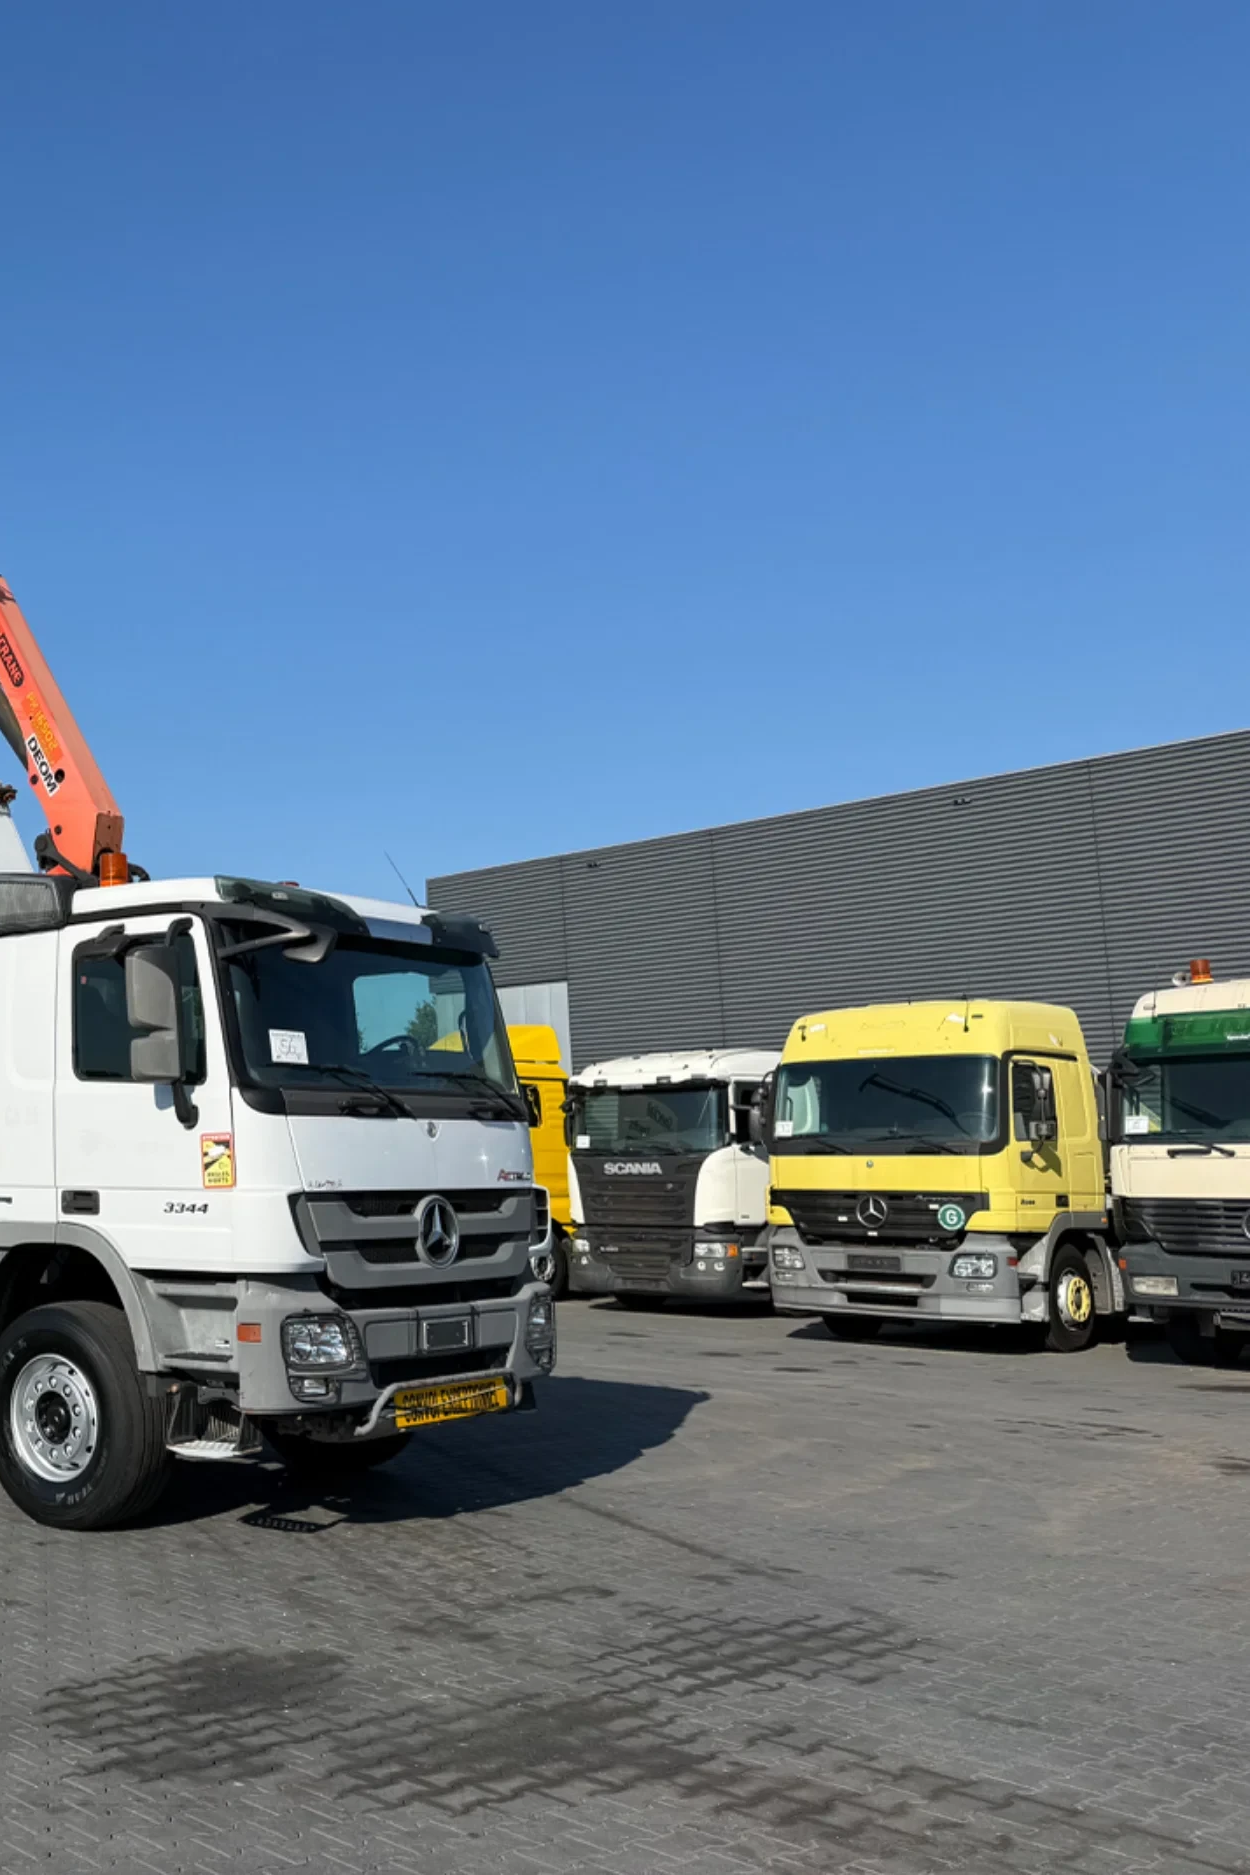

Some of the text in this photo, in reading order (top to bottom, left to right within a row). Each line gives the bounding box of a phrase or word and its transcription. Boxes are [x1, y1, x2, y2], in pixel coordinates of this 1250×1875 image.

[27, 735, 58, 793] DEOM
[603, 1162, 663, 1176] SCANIA
[163, 1202, 209, 1215] 3344
[946, 1210, 958, 1225] G
